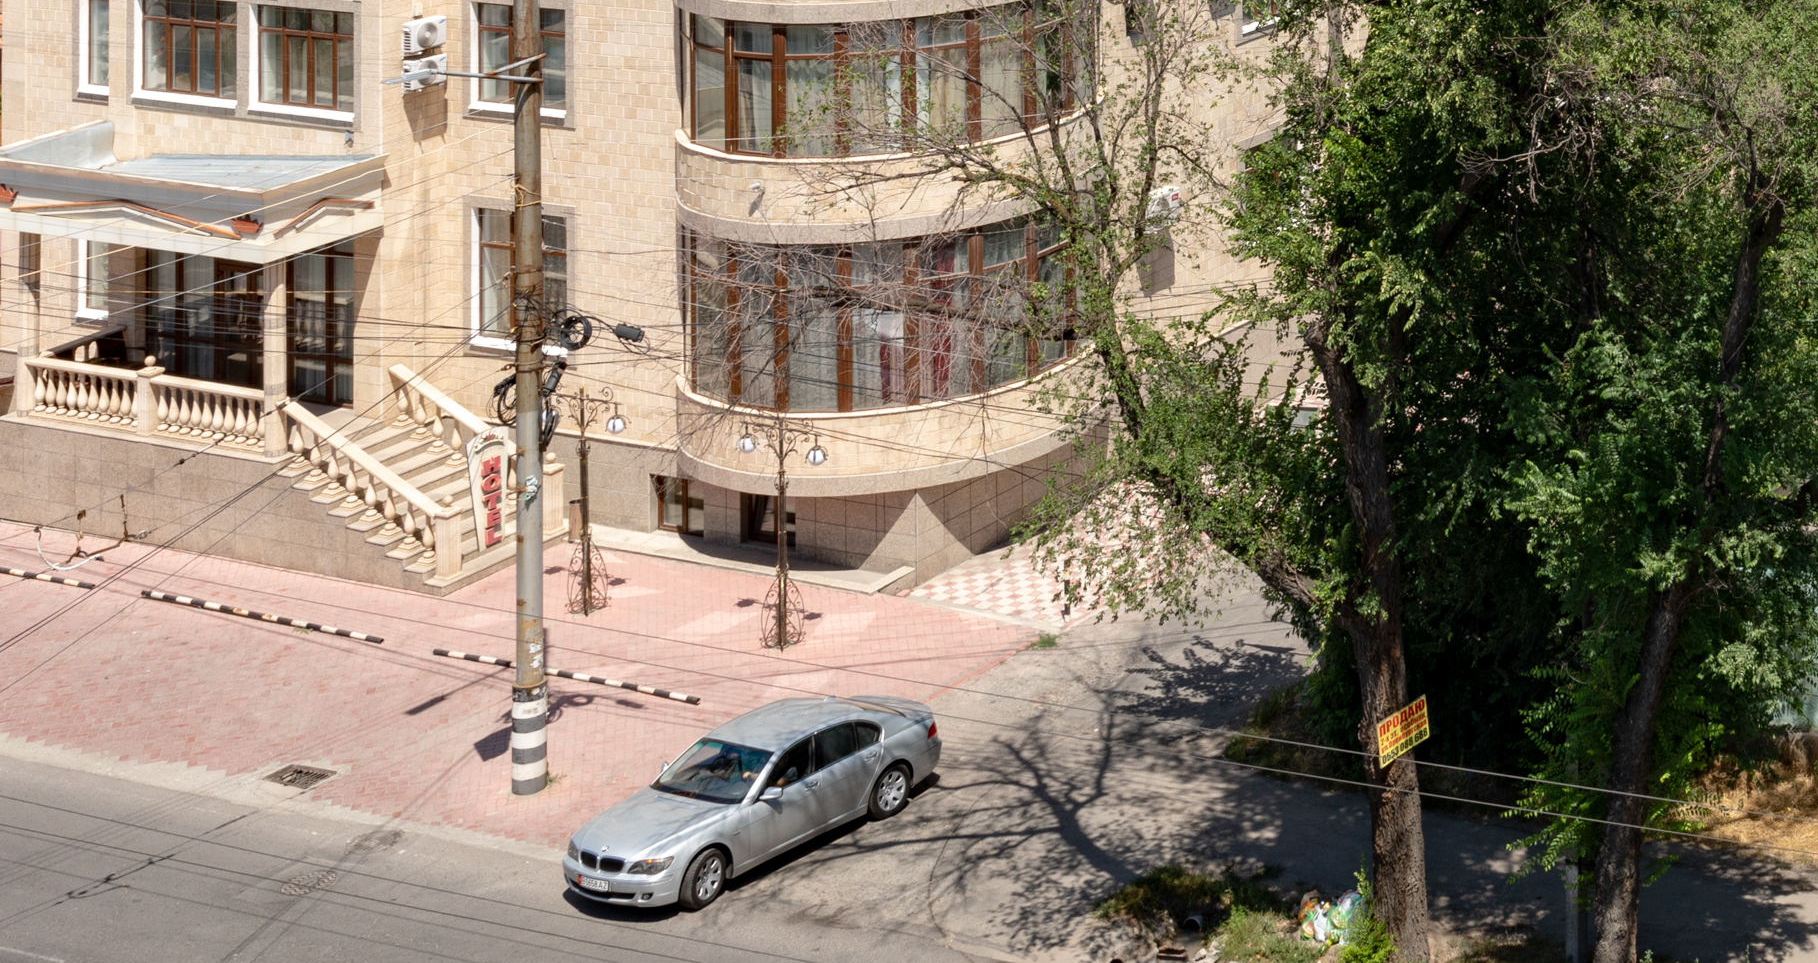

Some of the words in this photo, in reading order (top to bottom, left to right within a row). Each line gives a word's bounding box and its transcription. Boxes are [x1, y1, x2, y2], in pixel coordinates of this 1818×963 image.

[480, 455, 502, 546] HOTEL
[1379, 699, 1425, 737] ПРОДАЮ
[1382, 745, 1399, 765] 0553
[1400, 736, 1414, 752] 088
